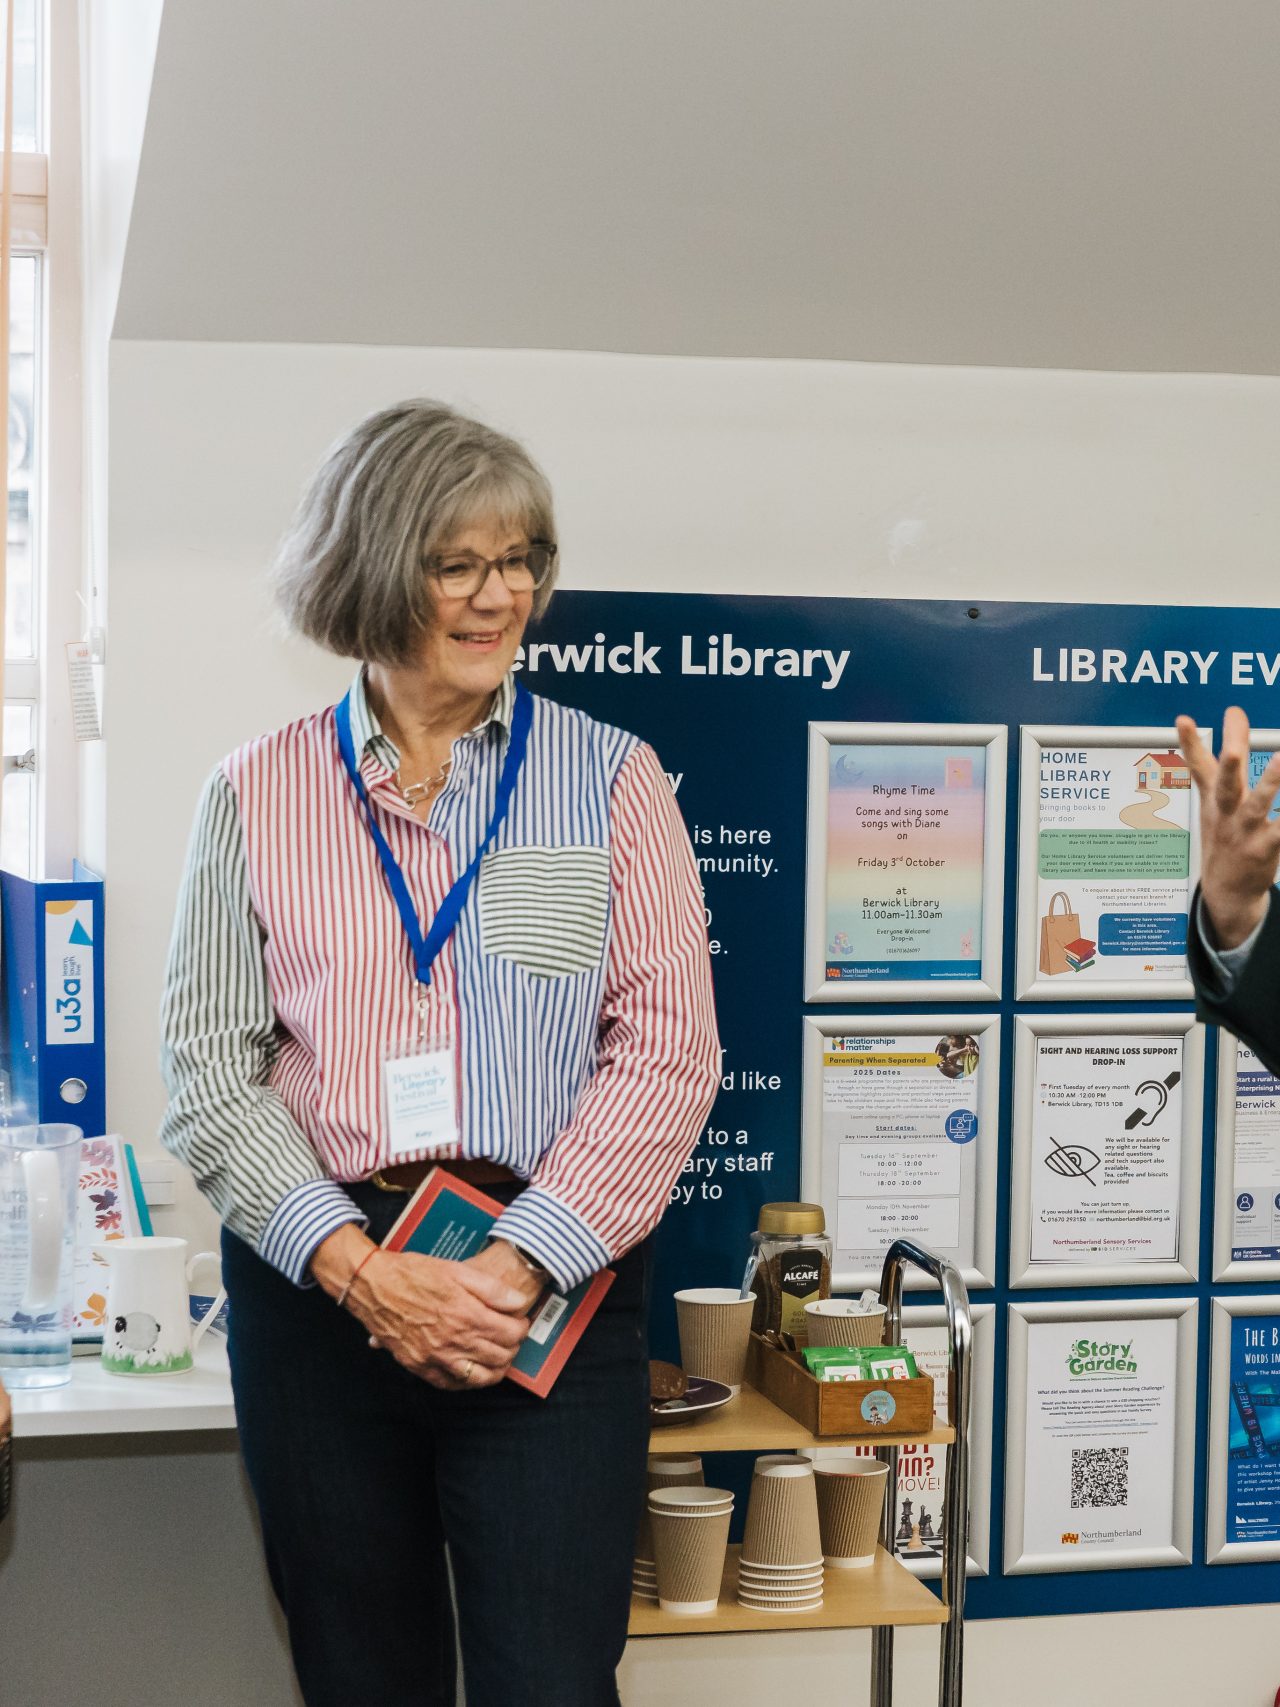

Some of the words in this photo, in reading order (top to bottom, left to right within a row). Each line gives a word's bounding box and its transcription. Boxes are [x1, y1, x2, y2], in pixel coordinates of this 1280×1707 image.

[510, 632, 661, 675] erwick
[681, 635, 850, 689] Library
[1033, 648, 1219, 684] LIBRARY
[1041, 752, 1088, 763] HOME
[1040, 770, 1111, 781] LIBRARY
[873, 785, 907, 798] Rhyme
[911, 785, 935, 795] Time
[1040, 788, 1110, 799] SERVICE
[856, 807, 881, 816] Come
[885, 807, 901, 816] and
[904, 808, 922, 818] sing
[862, 821, 888, 830] songs
[892, 820, 912, 828] with
[915, 819, 940, 828] Diane
[694, 825, 712, 844] is
[720, 825, 771, 844] here
[697, 854, 778, 877] munity.
[858, 858, 888, 869] Friday
[891, 856, 903, 866] 3rd
[906, 858, 945, 866] October
[863, 898, 901, 907] Berwick
[905, 898, 939, 909] Library
[862, 910, 942, 919] 11.00am-11.30am
[56, 979, 81, 1032] u3a
[743, 1072, 781, 1090] like
[1236, 1100, 1275, 1108] Berwick
[708, 1127, 728, 1144] to
[736, 1130, 748, 1144] a
[725, 1153, 774, 1171] staff
[701, 1182, 722, 1199] to
[784, 1270, 818, 1281] ALCAFÉ
[1078, 1340, 1130, 1358] Story
[1070, 1357, 1137, 1375] Garden
[1081, 1529, 1141, 1538] Northumberland
